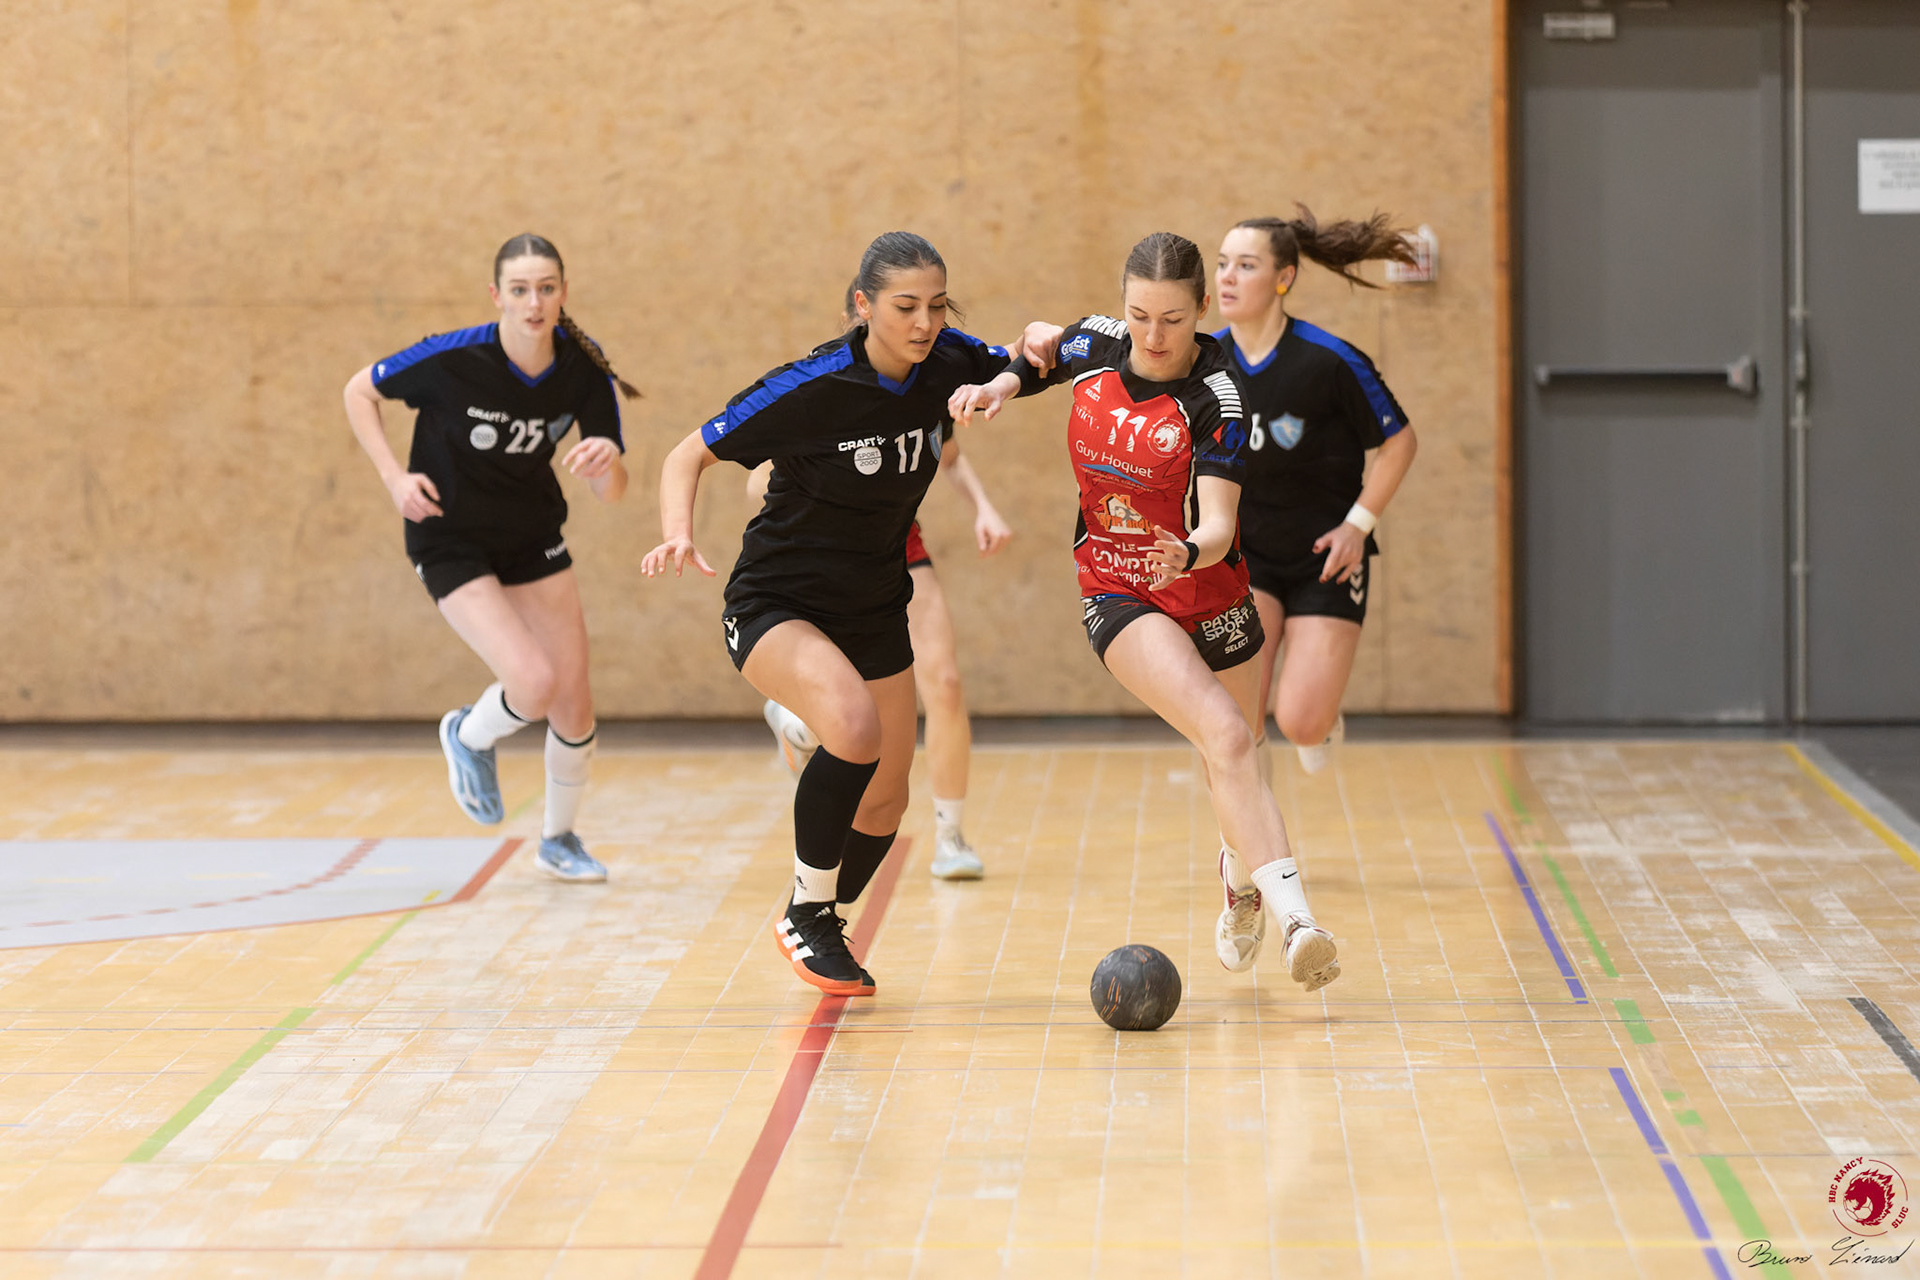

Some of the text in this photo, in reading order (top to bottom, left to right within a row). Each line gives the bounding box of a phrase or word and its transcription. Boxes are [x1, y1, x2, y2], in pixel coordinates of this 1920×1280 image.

[1084, 388, 1101, 402] SELECT
[466, 405, 501, 423] CRAFT
[505, 418, 545, 454] 25
[1109, 407, 1148, 453] 11
[838, 437, 876, 452] CRAFT
[894, 428, 923, 474] 17
[860, 459, 878, 467] 2000
[1075, 440, 1153, 479] Guy Hoquet
[1122, 543, 1136, 552] LE
[1201, 607, 1240, 631] PAYS
[1204, 608, 1250, 641] SPORT
[1224, 636, 1249, 654] SELECT
